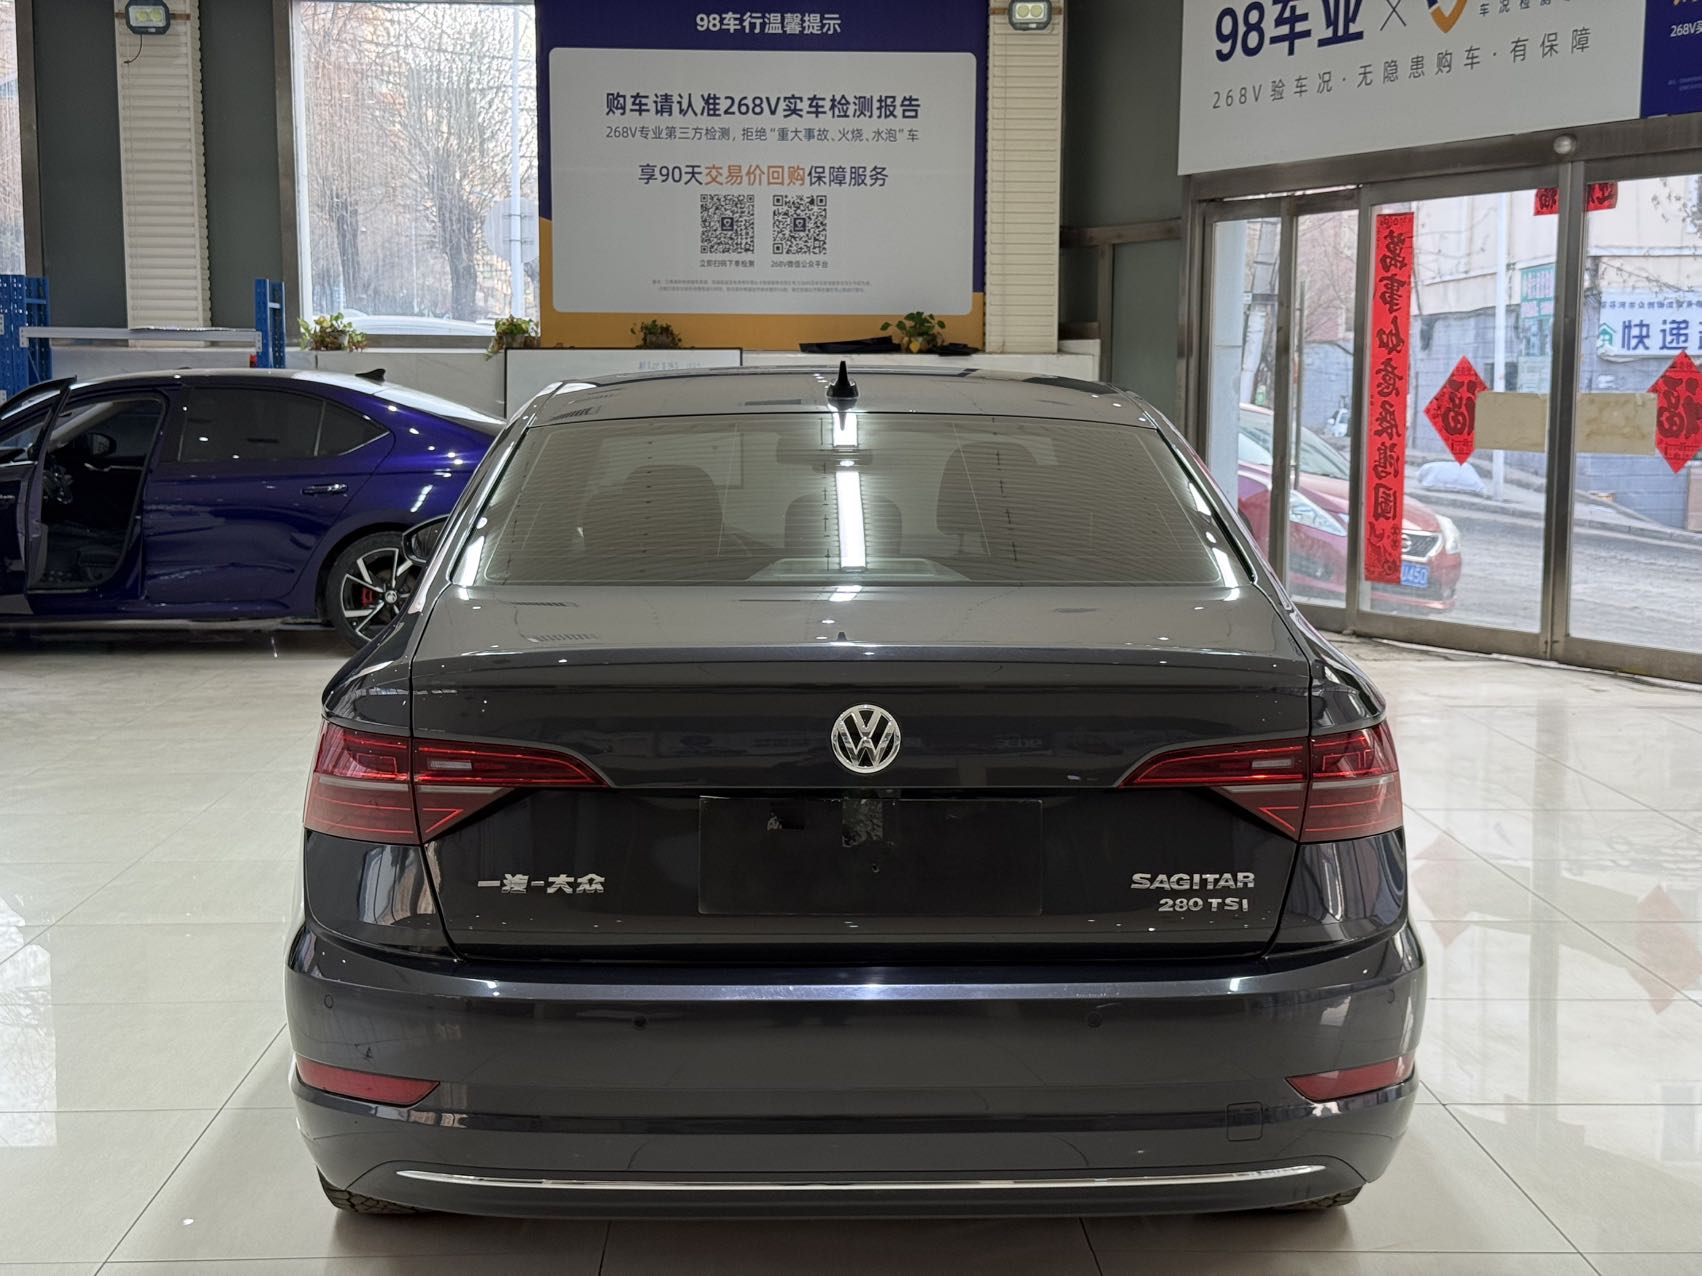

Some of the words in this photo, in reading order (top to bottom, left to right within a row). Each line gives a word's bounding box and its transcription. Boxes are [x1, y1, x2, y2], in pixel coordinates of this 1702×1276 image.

[696, 12, 841, 34] 98车行温馨提示
[606, 92, 920, 119] 购车请认准268V实车检测报告
[638, 164, 889, 187] 享90天交易价回购保障服务
[1621, 319, 1702, 351] 快递
[477, 873, 605, 894] 一汽-大众
[1130, 872, 1255, 890] SAGITAR
[1158, 897, 1203, 912] 280
[1207, 897, 1249, 912] TSI
